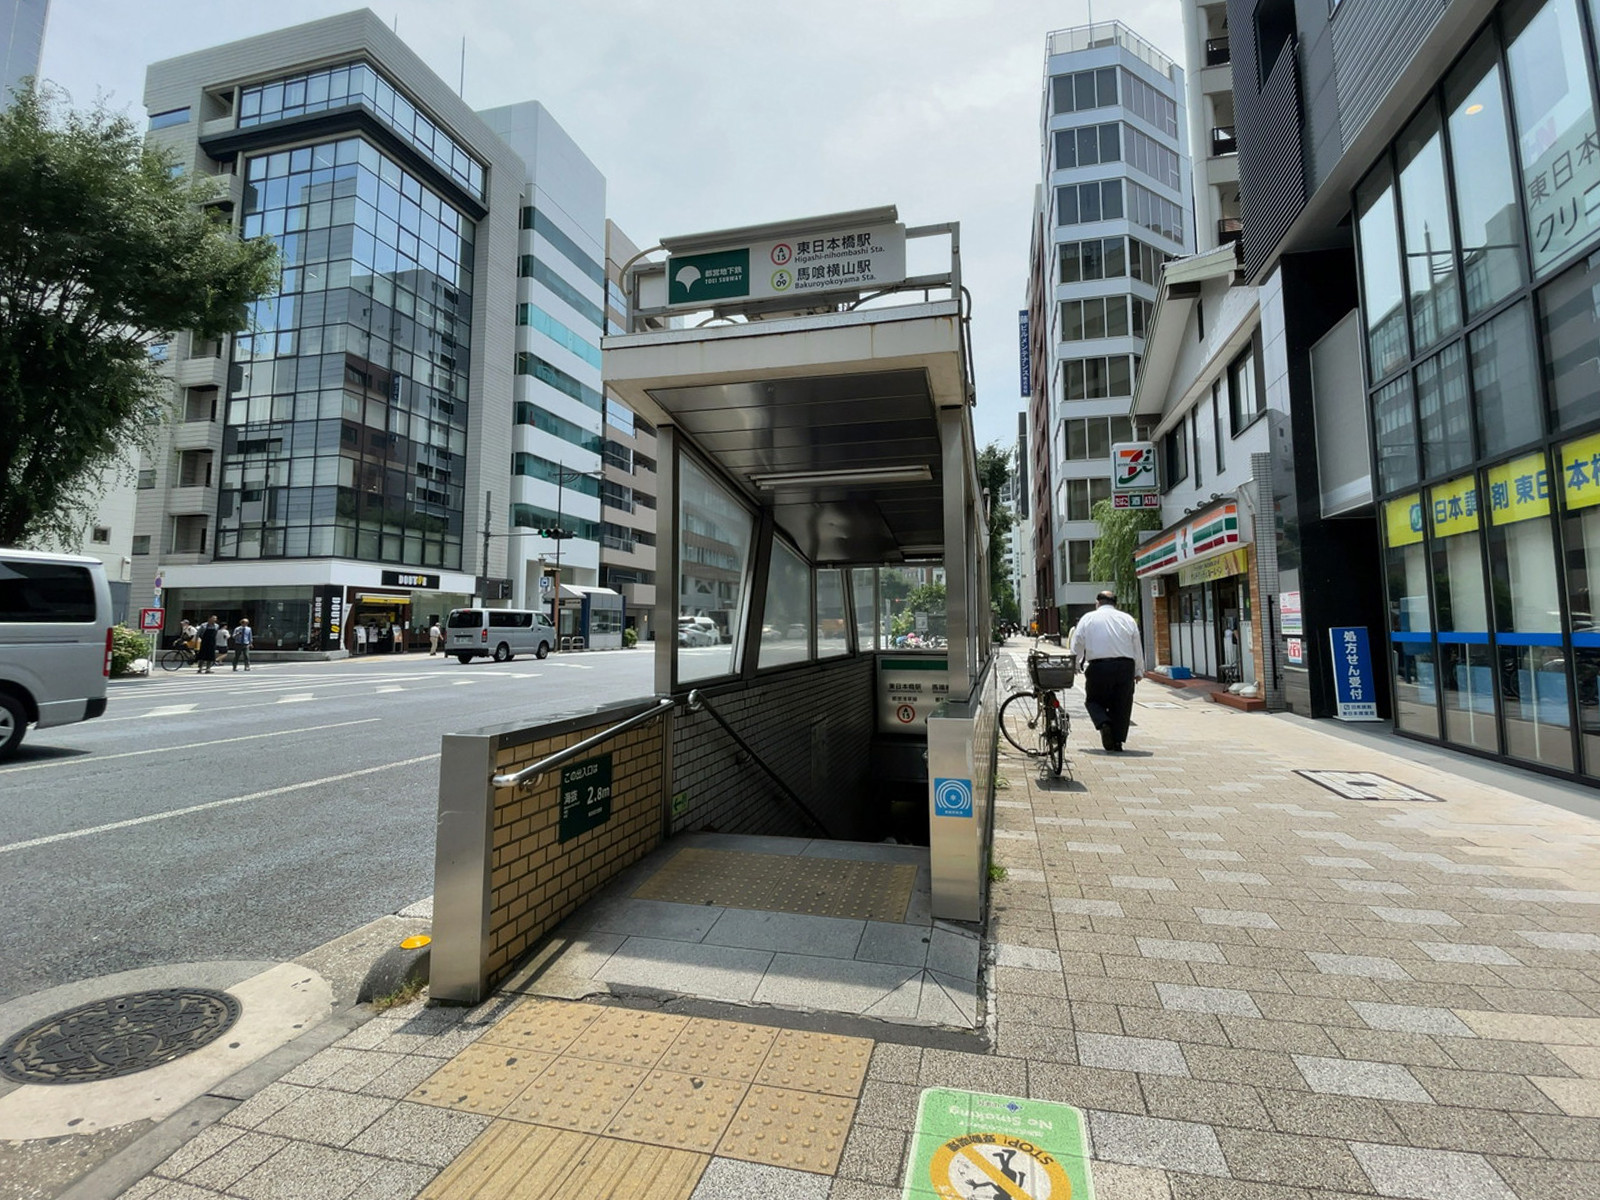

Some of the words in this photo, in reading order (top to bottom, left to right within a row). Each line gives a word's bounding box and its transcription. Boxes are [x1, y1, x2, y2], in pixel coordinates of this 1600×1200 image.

[778, 246, 785, 254] A
[796, 232, 871, 256] 東日本橋駅
[776, 253, 788, 262] 15
[794, 247, 869, 264] Higashi-nihombashi
[869, 246, 886, 254] Sta.
[704, 266, 742, 276] 都営地下鉄
[797, 259, 871, 282] 馬喰横山駅
[704, 277, 718, 285] TOEI
[719, 275, 742, 284] SUBWAY
[775, 279, 788, 288] 09
[794, 275, 861, 290] Bakuroyokoyama
[861, 273, 877, 282] Sta.
[1144, 495, 1158, 505] ATM
[398, 574, 427, 586] DOUTOR
[329, 596, 341, 640] DOUTOR
[1343, 630, 1363, 701] 処方せん受付
[587, 786, 610, 805] 2.8m
[949, 1104, 1022, 1127] Smoking
[1003, 1136, 1054, 1165] STOP!
